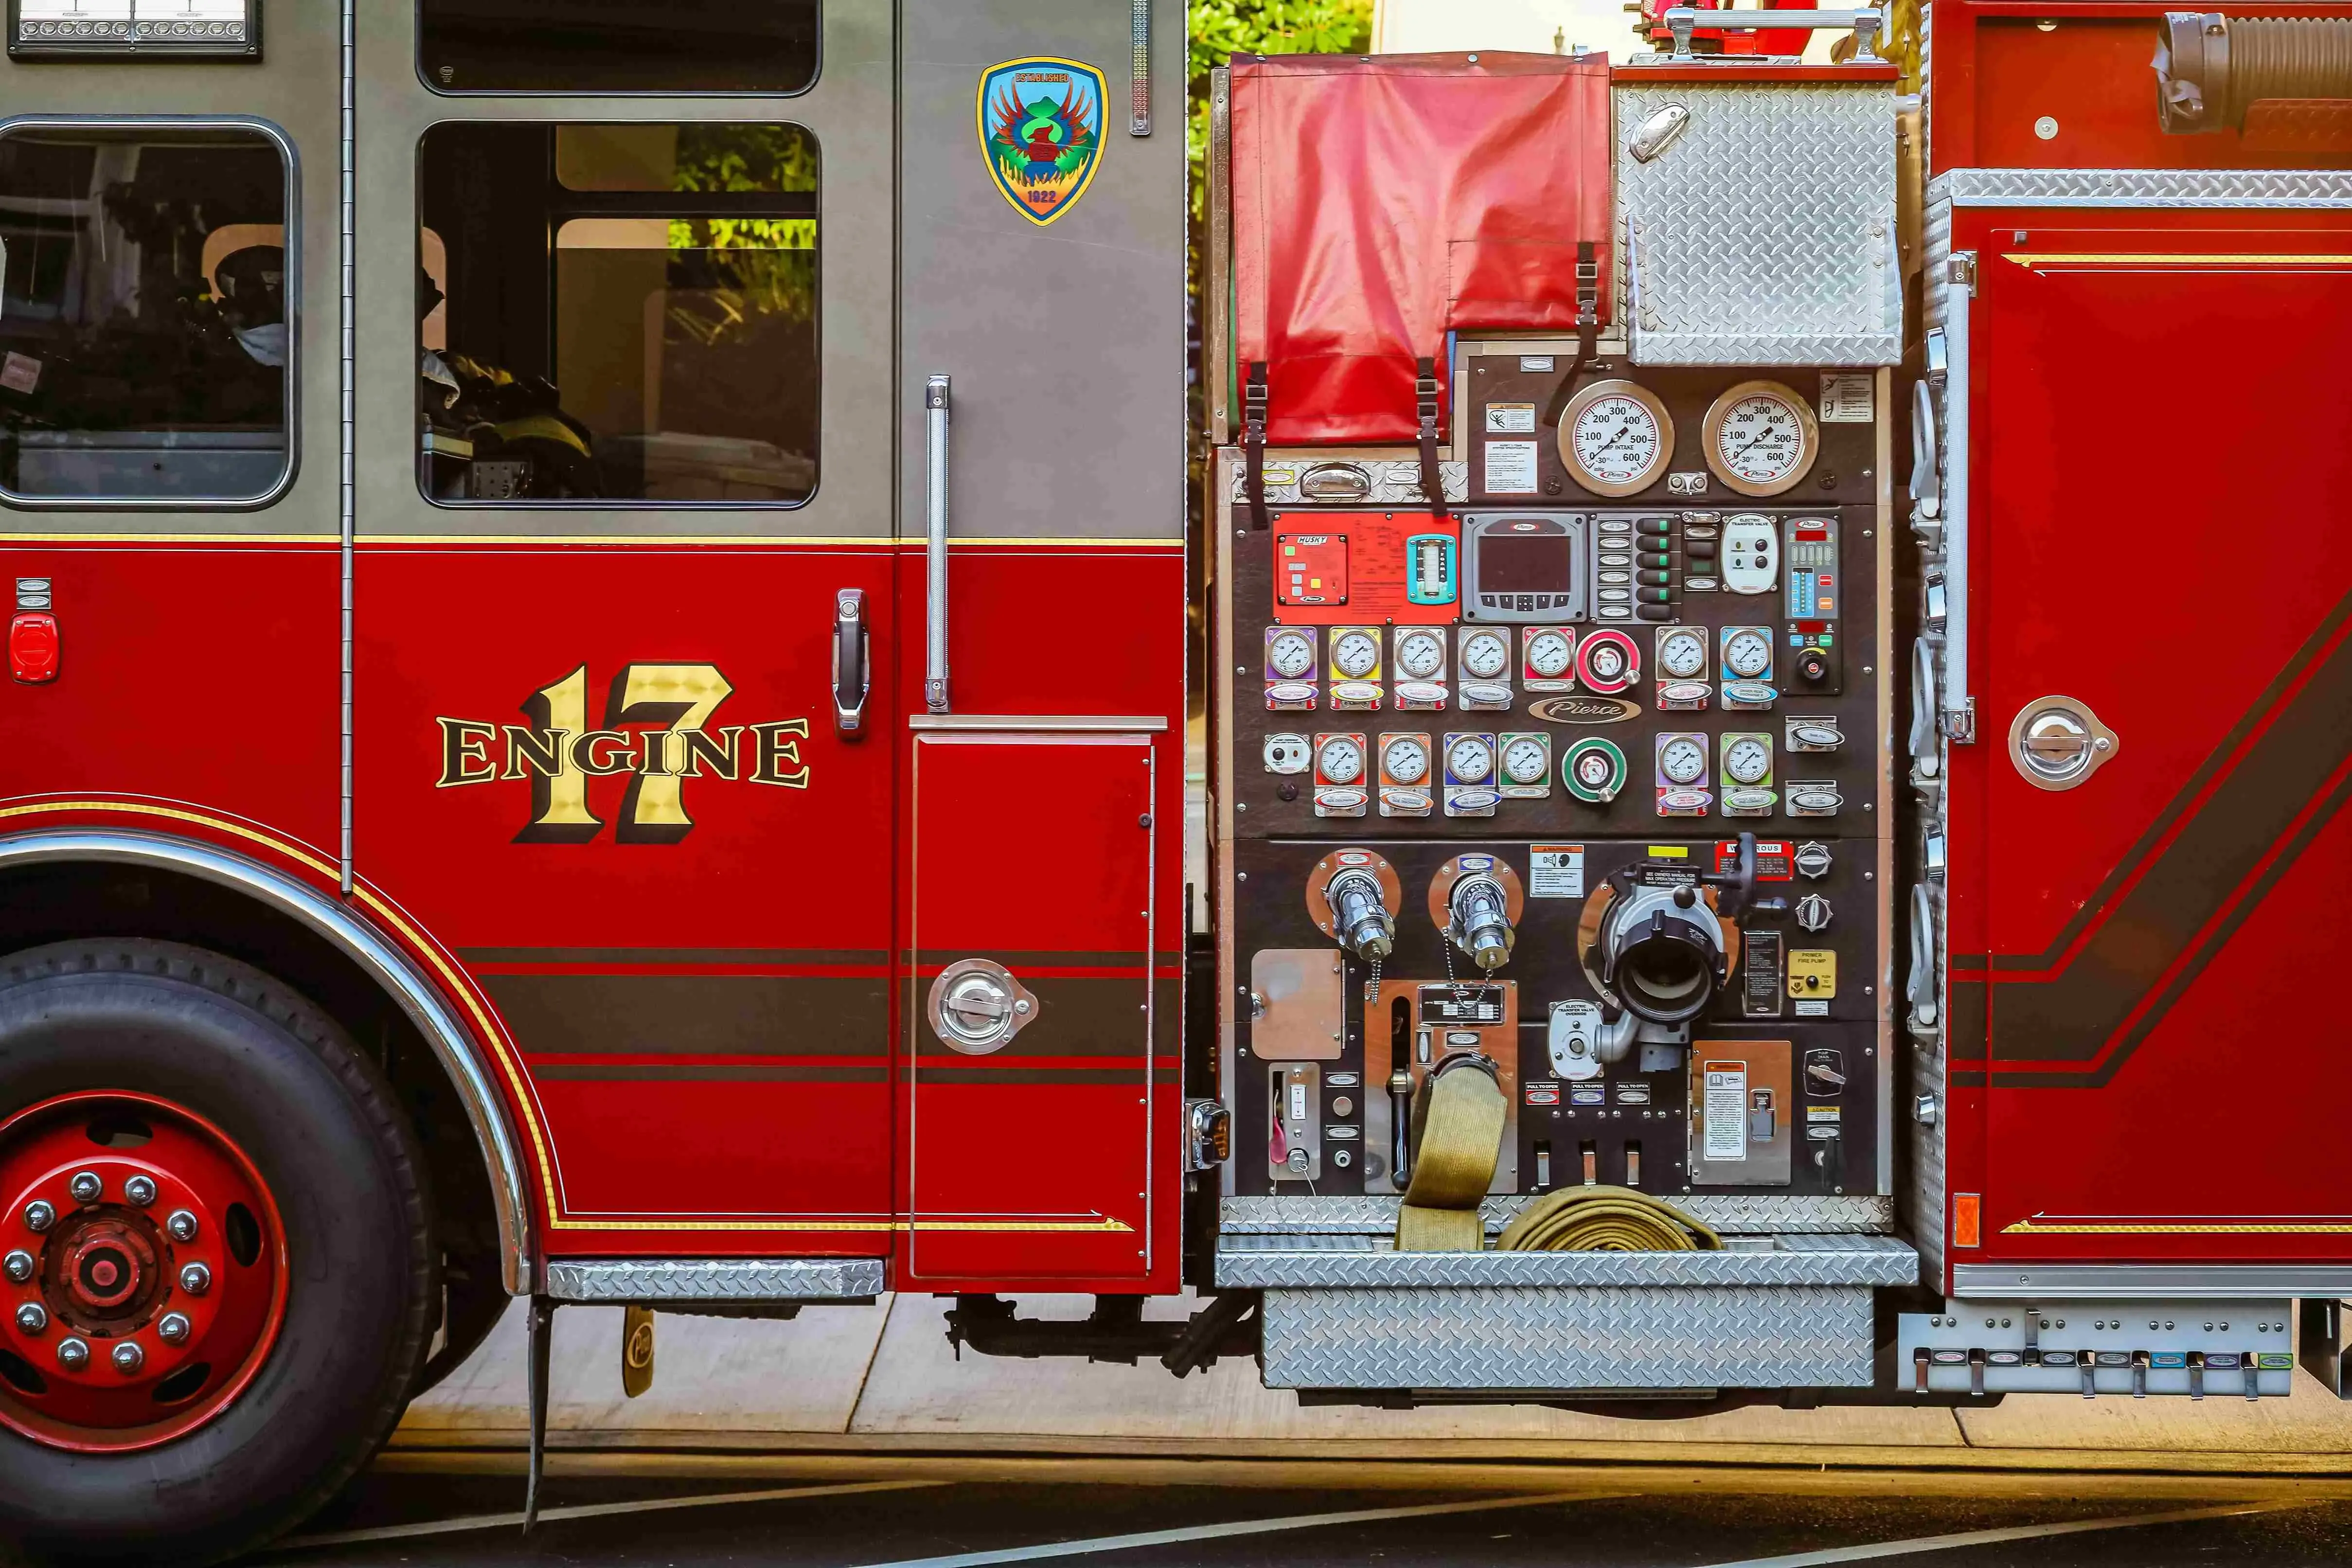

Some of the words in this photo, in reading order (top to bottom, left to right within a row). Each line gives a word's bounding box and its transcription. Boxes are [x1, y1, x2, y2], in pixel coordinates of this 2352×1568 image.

[1016, 73, 1069, 82] ESTABLISHED
[1028, 190, 1056, 203] 1922
[1548, 701, 1622, 715] Pierce
[434, 716, 810, 790] ENGINE
[510, 661, 734, 844] 17
